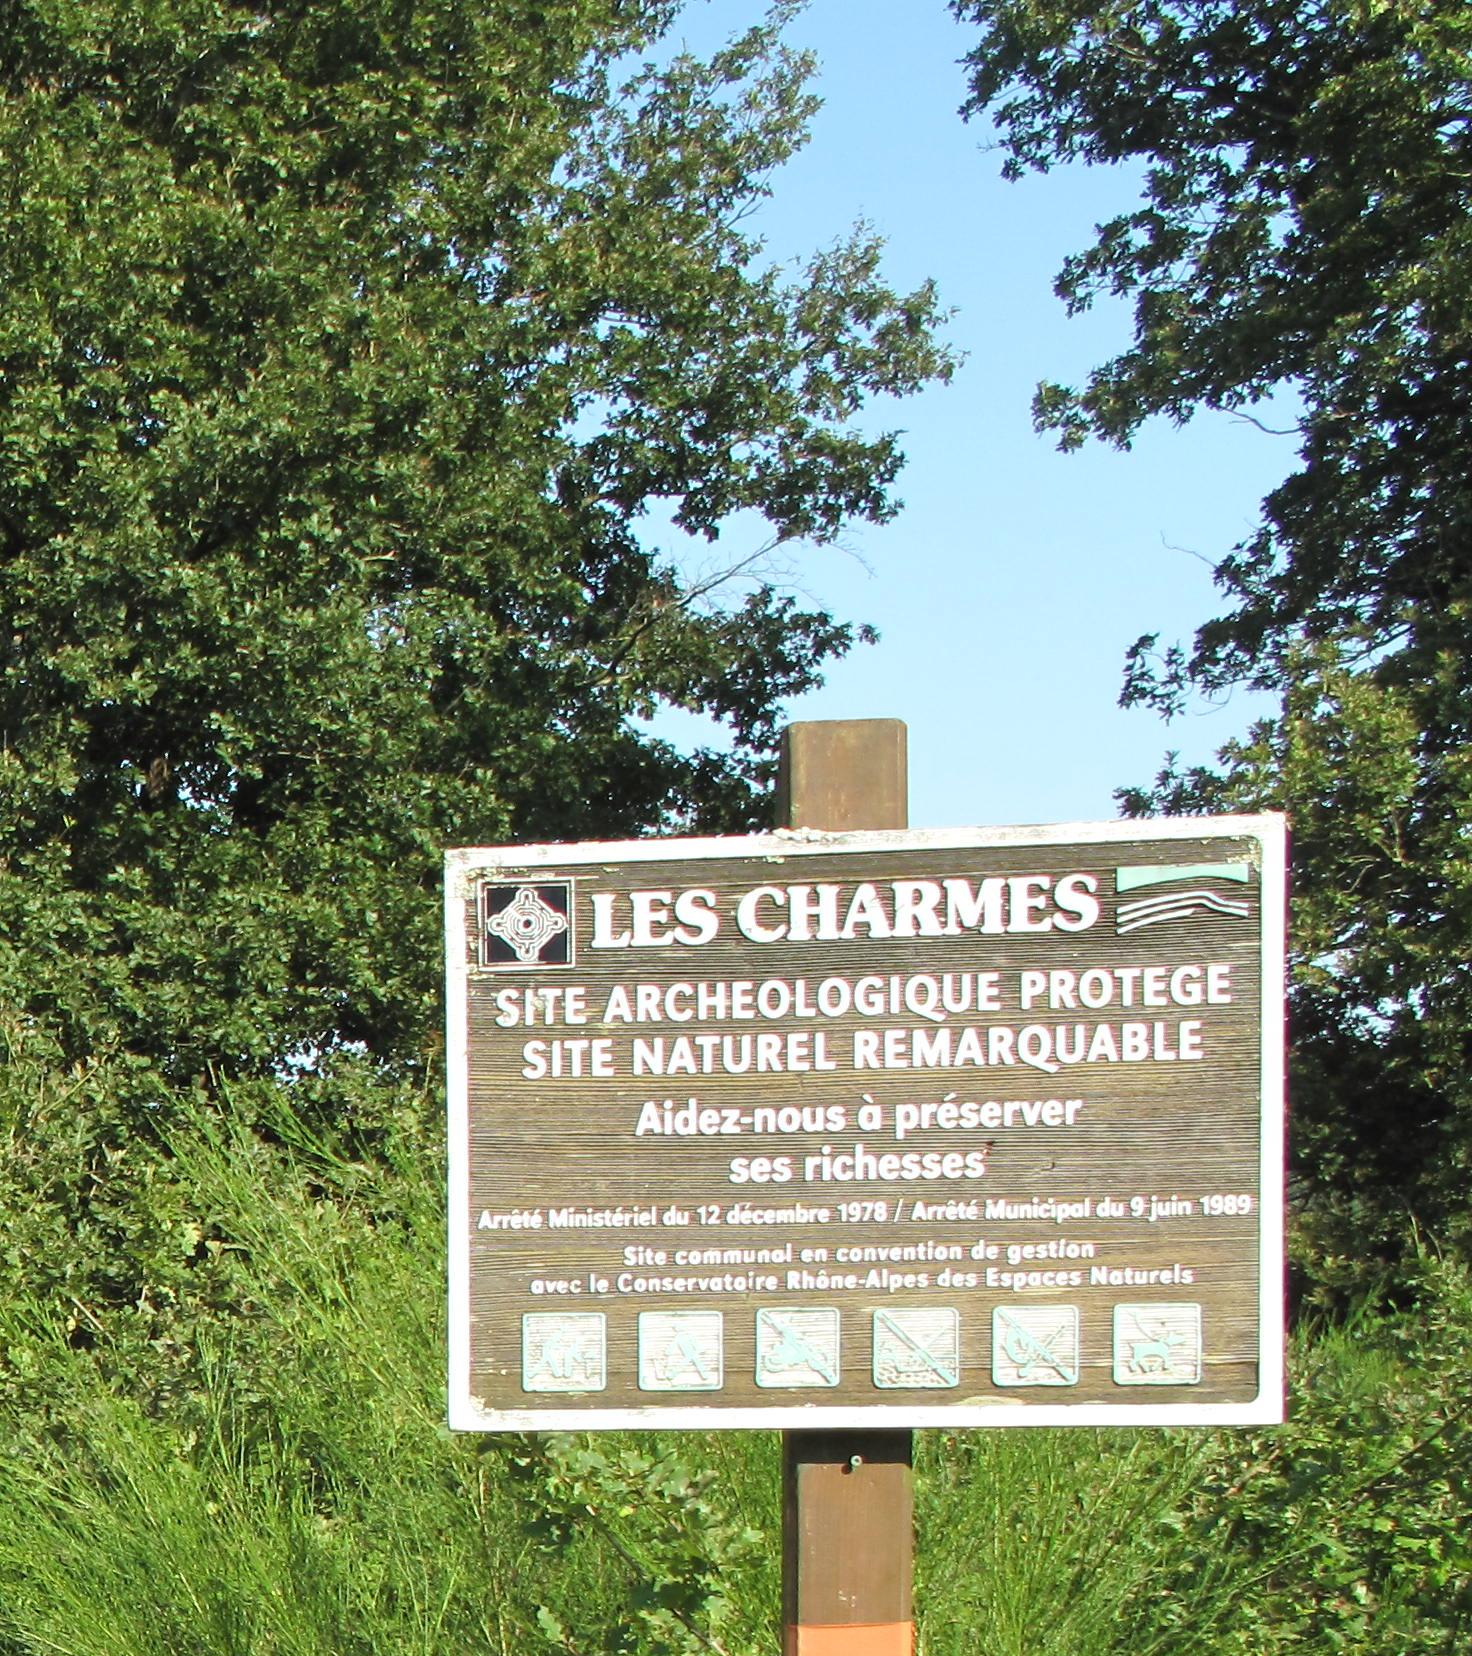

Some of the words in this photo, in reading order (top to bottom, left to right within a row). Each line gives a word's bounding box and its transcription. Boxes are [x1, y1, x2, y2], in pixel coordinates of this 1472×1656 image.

[590, 889, 720, 949] LES
[736, 873, 1100, 944] CHARMES
[494, 986, 588, 1028] SITE
[603, 972, 1001, 1023] ARCHEOLOGIQUE
[1020, 964, 1232, 1010] PROTEGE
[521, 1038, 616, 1080] SITE
[632, 1030, 837, 1076] NATUREL
[853, 1020, 1205, 1073] REMARQUABLE
[635, 1097, 846, 1137] Aidez-nous
[857, 1093, 883, 1132] à
[895, 1092, 1083, 1140] préserver
[728, 1156, 792, 1183] ses
[804, 1143, 986, 1182] richesses
[477, 1210, 543, 1231] Arrêté
[549, 1207, 657, 1229] Ministériel
[662, 1205, 690, 1227] du
[696, 1205, 722, 1226] 12
[726, 1202, 831, 1226] décembre
[836, 1201, 888, 1223] 1978
[894, 1198, 904, 1223] /
[911, 1200, 979, 1221] Arrêté
[985, 1198, 1091, 1224] Municipal
[1095, 1196, 1124, 1217] du
[1130, 1195, 1144, 1217] 9
[1148, 1194, 1192, 1222] juin
[1198, 1194, 1252, 1216] 1989
[623, 1245, 666, 1267] Site
[674, 1243, 793, 1266] communal
[800, 1247, 828, 1264] en
[836, 1240, 963, 1262] convention
[970, 1239, 1000, 1261] de
[1006, 1238, 1096, 1265] gestion
[530, 1276, 582, 1295] avec
[589, 1273, 609, 1295] le
[616, 1271, 778, 1294] Conservatoire
[786, 1268, 930, 1294] Rhône-Alpes
[936, 1266, 978, 1289] des
[986, 1266, 1083, 1293] Espaces
[1090, 1263, 1195, 1286] Naturels
